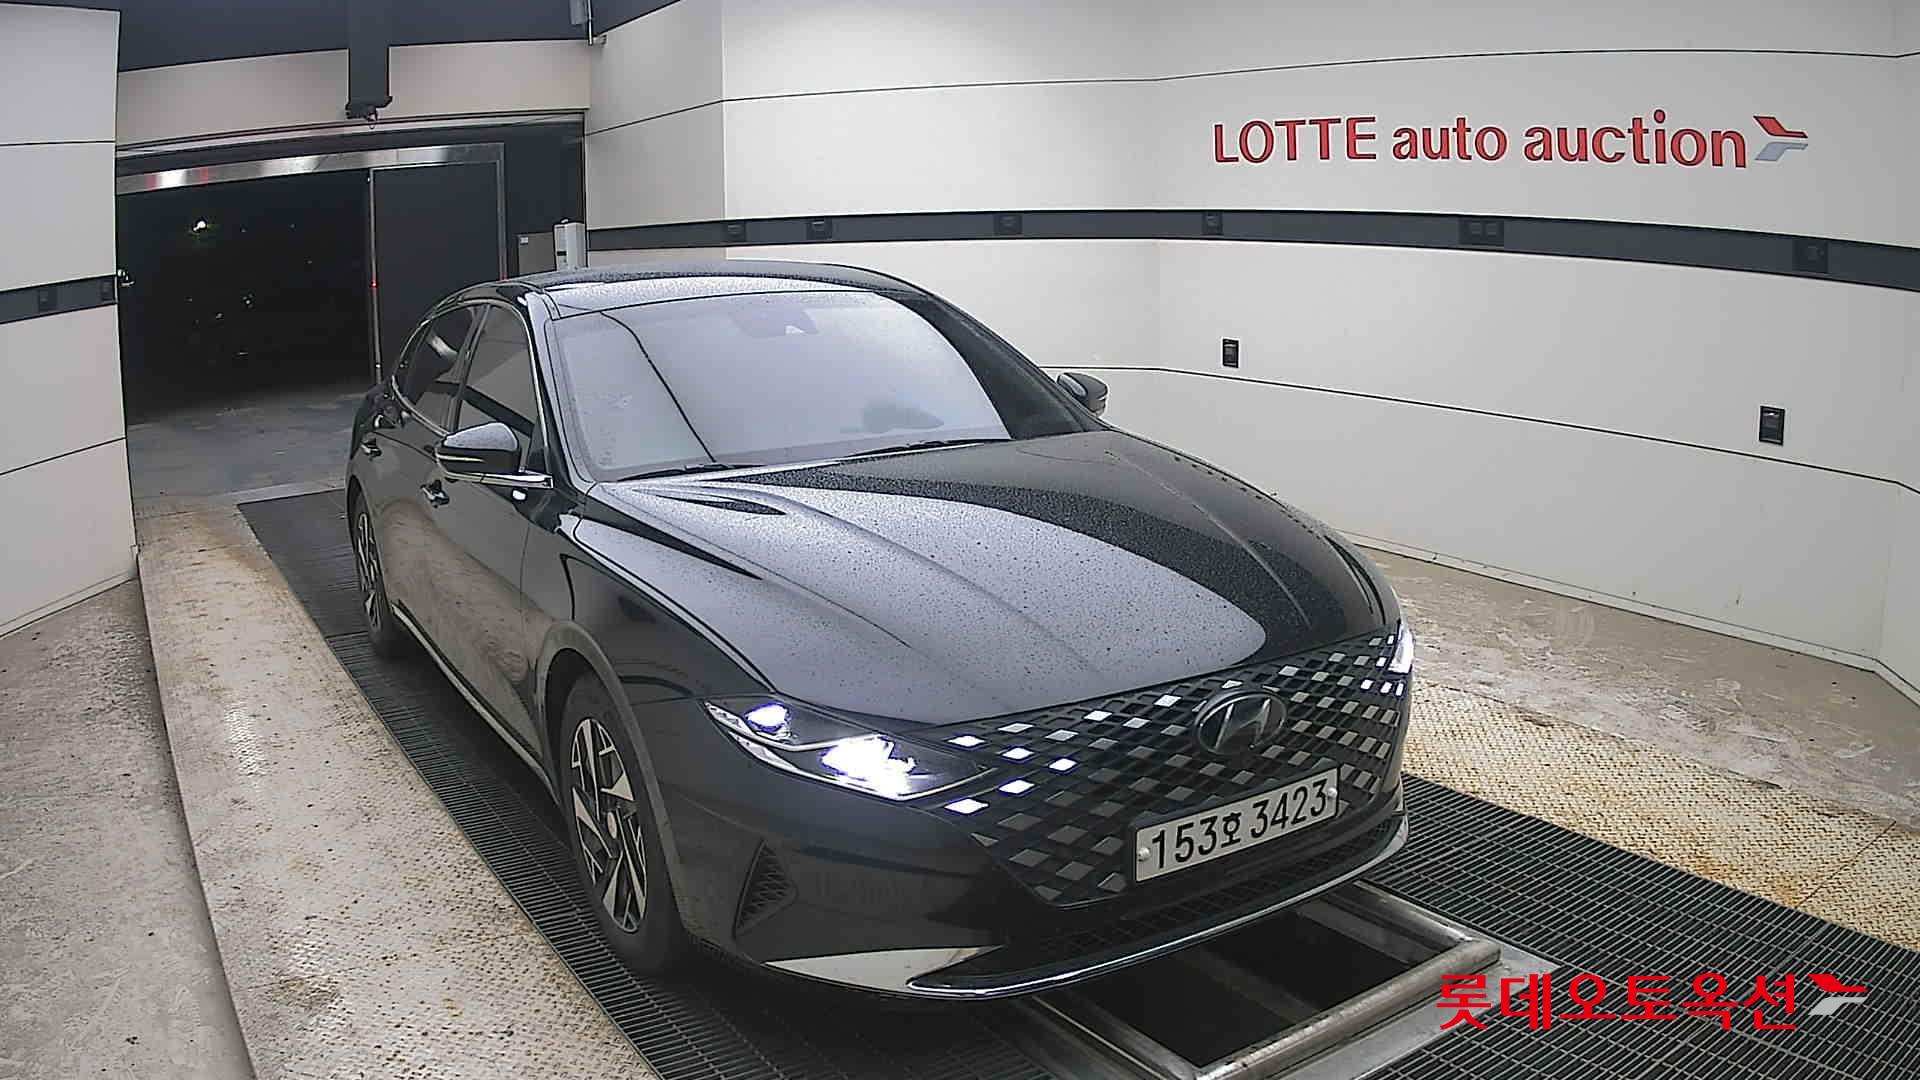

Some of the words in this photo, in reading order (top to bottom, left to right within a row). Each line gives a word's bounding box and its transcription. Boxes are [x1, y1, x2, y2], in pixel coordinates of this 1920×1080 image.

[1213, 116, 1377, 163] LOTTE
[1392, 117, 1508, 161] auto
[1523, 108, 1747, 169] auction
[1152, 811, 1242, 869] 153호
[1250, 778, 1328, 838] 3423
